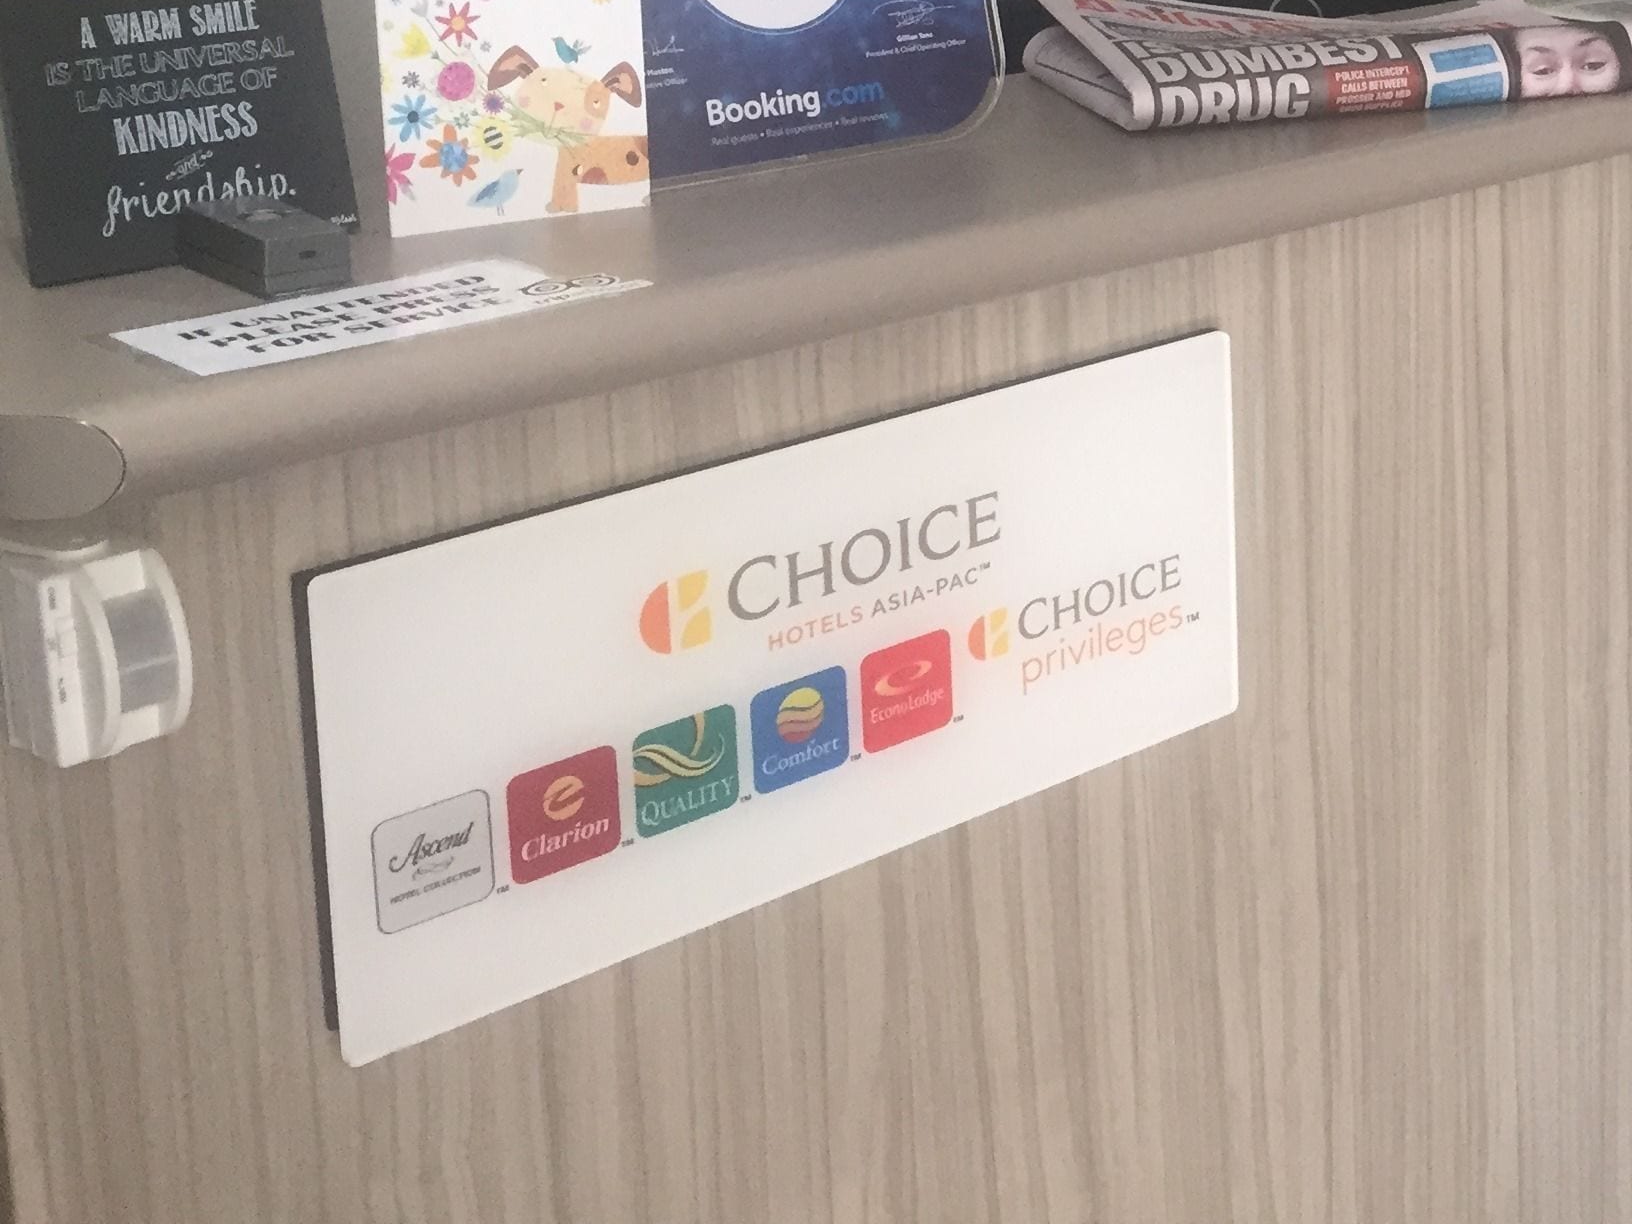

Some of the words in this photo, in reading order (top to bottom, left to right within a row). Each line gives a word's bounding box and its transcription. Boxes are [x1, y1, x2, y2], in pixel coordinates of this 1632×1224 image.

[80, 17, 97, 49] A
[105, 7, 182, 45] WARM
[189, 0, 260, 36] SMILE
[45, 62, 71, 86] IS
[76, 54, 136, 81] THE
[139, 35, 295, 73] UNIVERSAL
[1142, 35, 1403, 83] DUMBEST
[1335, 69, 1364, 82] POLICE
[1365, 65, 1410, 79] INTERCEPT
[75, 72, 236, 112] LANGUAGE
[240, 67, 277, 91] OF
[1158, 73, 1310, 127] DRUG
[1341, 80, 1367, 94] CALLS
[1369, 77, 1408, 91] BETWEEN
[113, 101, 258, 156] KINDNESS
[208, 313, 362, 347] PLEASE
[374, 285, 500, 314] PRESS
[230, 276, 485, 328] UNATTENDED
[247, 332, 337, 353] FOR
[343, 297, 512, 334] SERVICE
[727, 490, 1002, 621] CHOICE
[1017, 553, 1182, 640] CHOICE
[767, 605, 864, 652] HOTELS
[761, 737, 841, 777] Comfort
[641, 776, 736, 827] QUALITY
[388, 821, 474, 873] Ascend
[520, 816, 610, 864] Clarion
